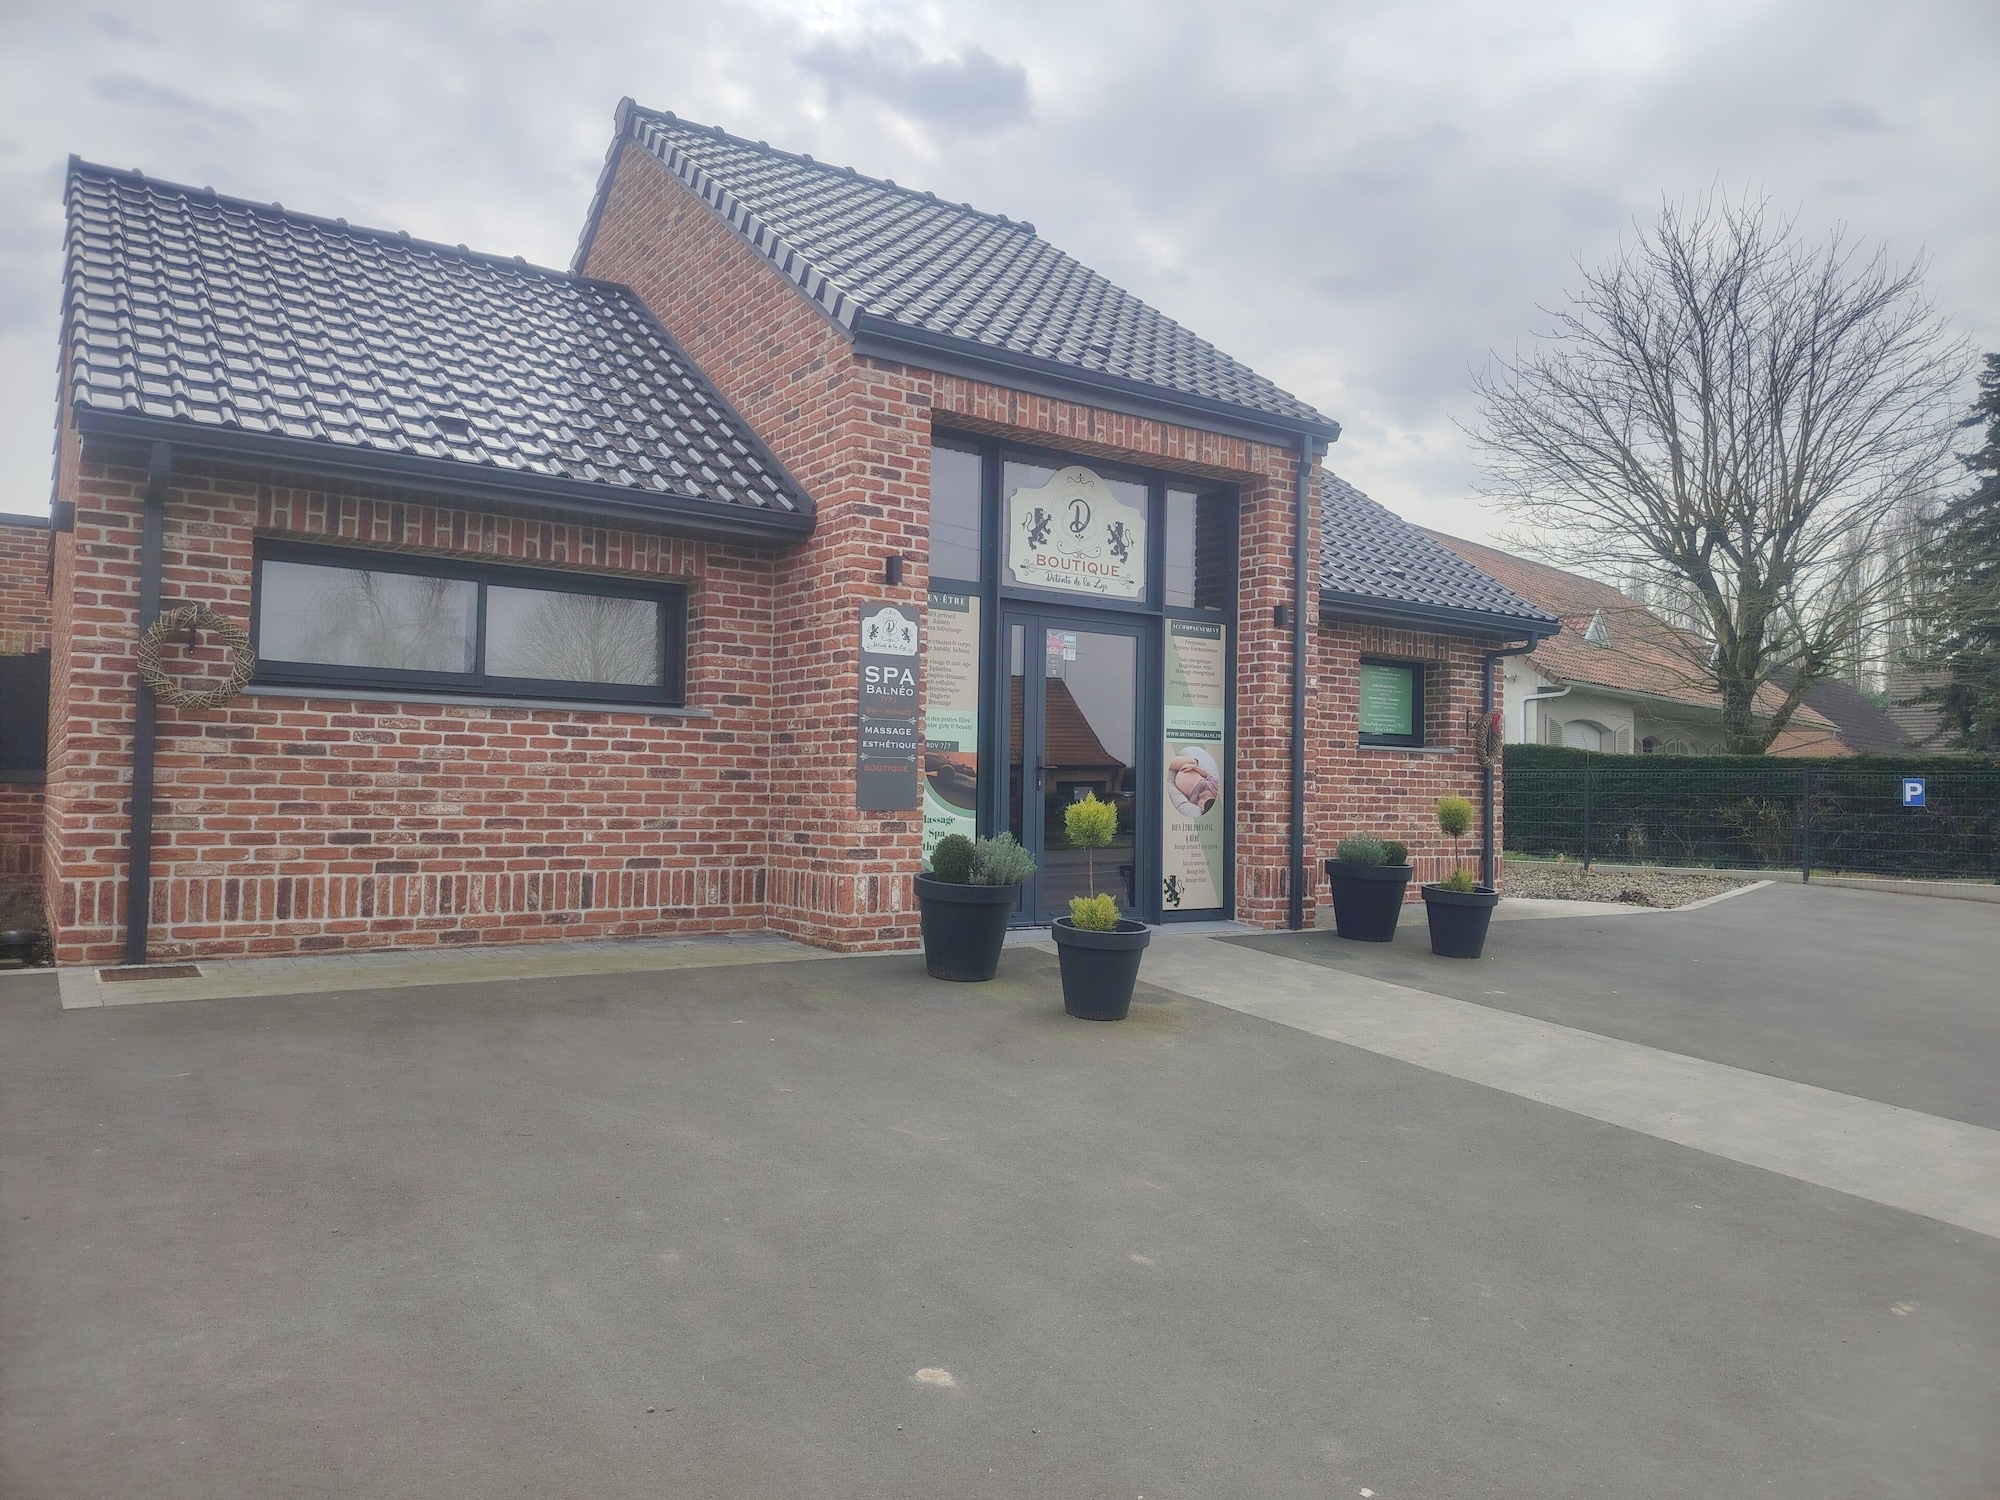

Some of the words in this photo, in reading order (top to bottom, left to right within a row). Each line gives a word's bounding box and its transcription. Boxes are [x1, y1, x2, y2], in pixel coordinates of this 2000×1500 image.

[1068, 499, 1091, 533] D
[1036, 554, 1120, 577] BOUTIQUE
[1073, 578, 1081, 587] de
[1083, 577, 1091, 587] la
[1093, 579, 1108, 592] Lys
[1172, 624, 1219, 633] ACCOMPAGNEMENT
[865, 665, 915, 686] SPA
[866, 684, 914, 696] BALNÉO
[865, 727, 912, 736] MASSAGE
[956, 722, 972, 731] beauty
[862, 740, 917, 749] ESTHÉTIQUE
[940, 742, 951, 750] 7/7
[864, 764, 909, 772] BOUTIQUE
[1905, 783, 1923, 801] P
[928, 829, 945, 840] Spa
